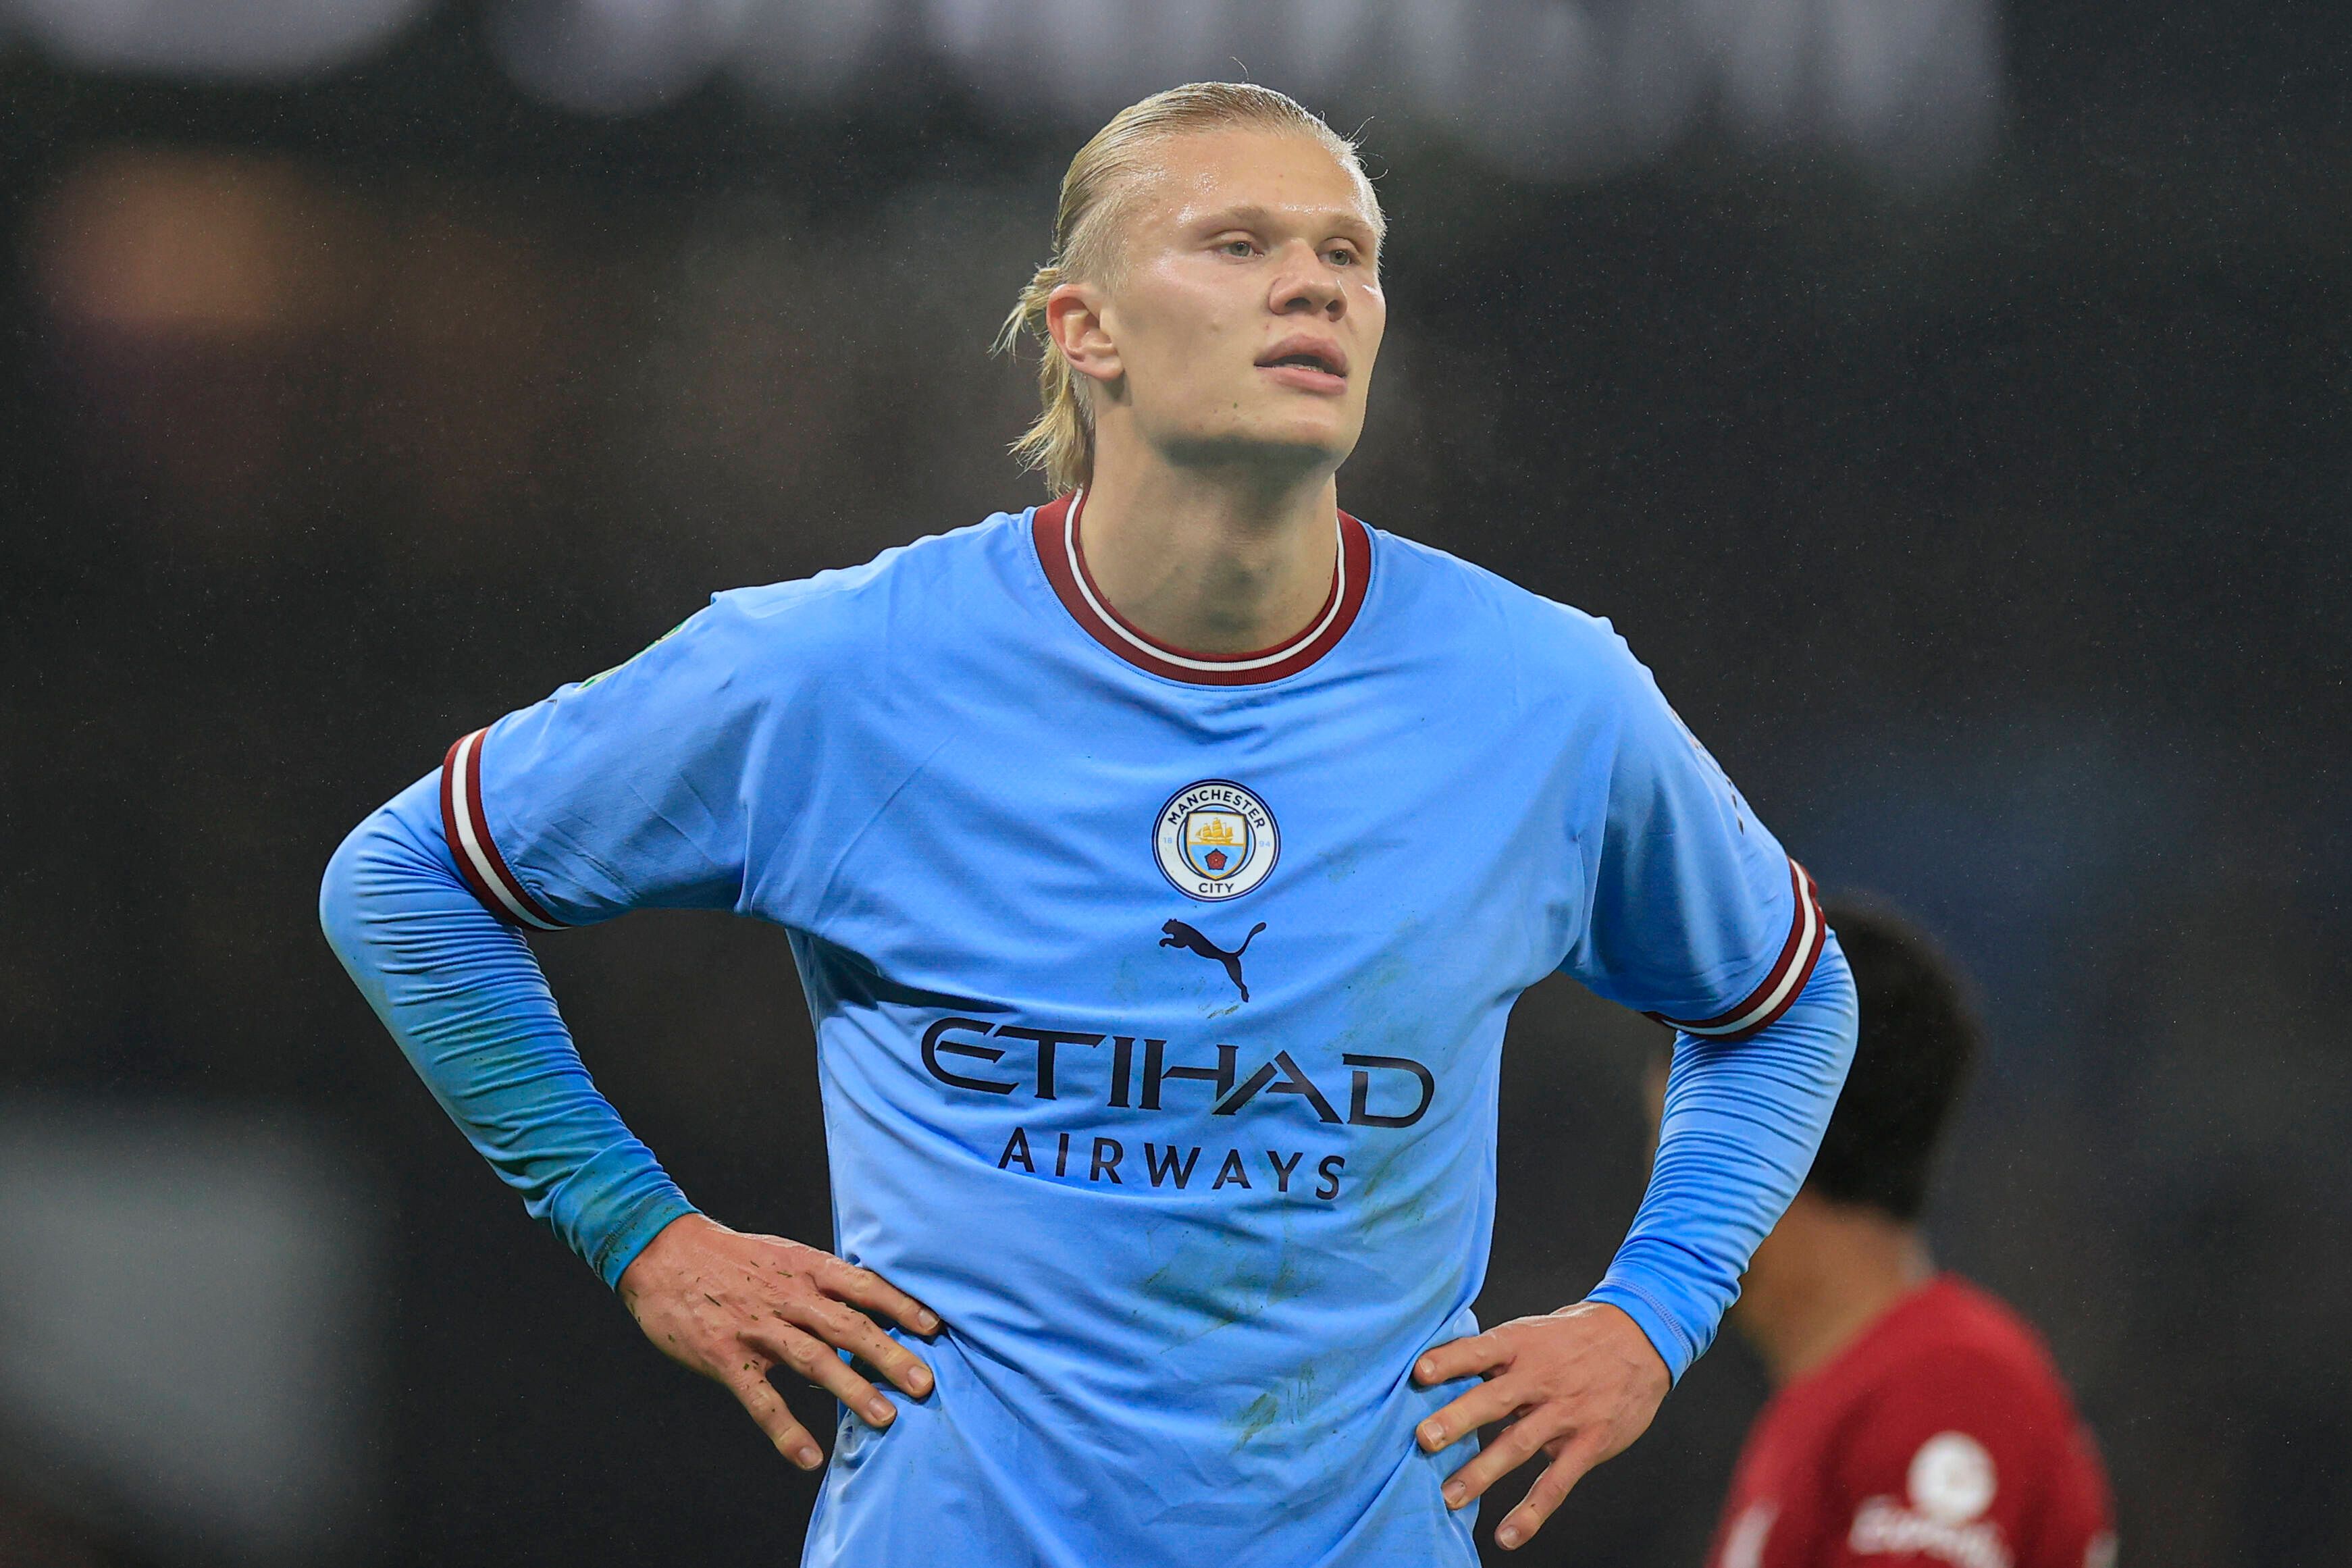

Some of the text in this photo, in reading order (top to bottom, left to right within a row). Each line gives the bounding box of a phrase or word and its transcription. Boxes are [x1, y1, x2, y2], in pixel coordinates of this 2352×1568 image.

[1168, 789, 1265, 829] MANCHESTER
[1198, 883, 1234, 894] CITY
[920, 1016, 1435, 1129] ETIHAD
[997, 1126, 1347, 1201] AIRWAYS
